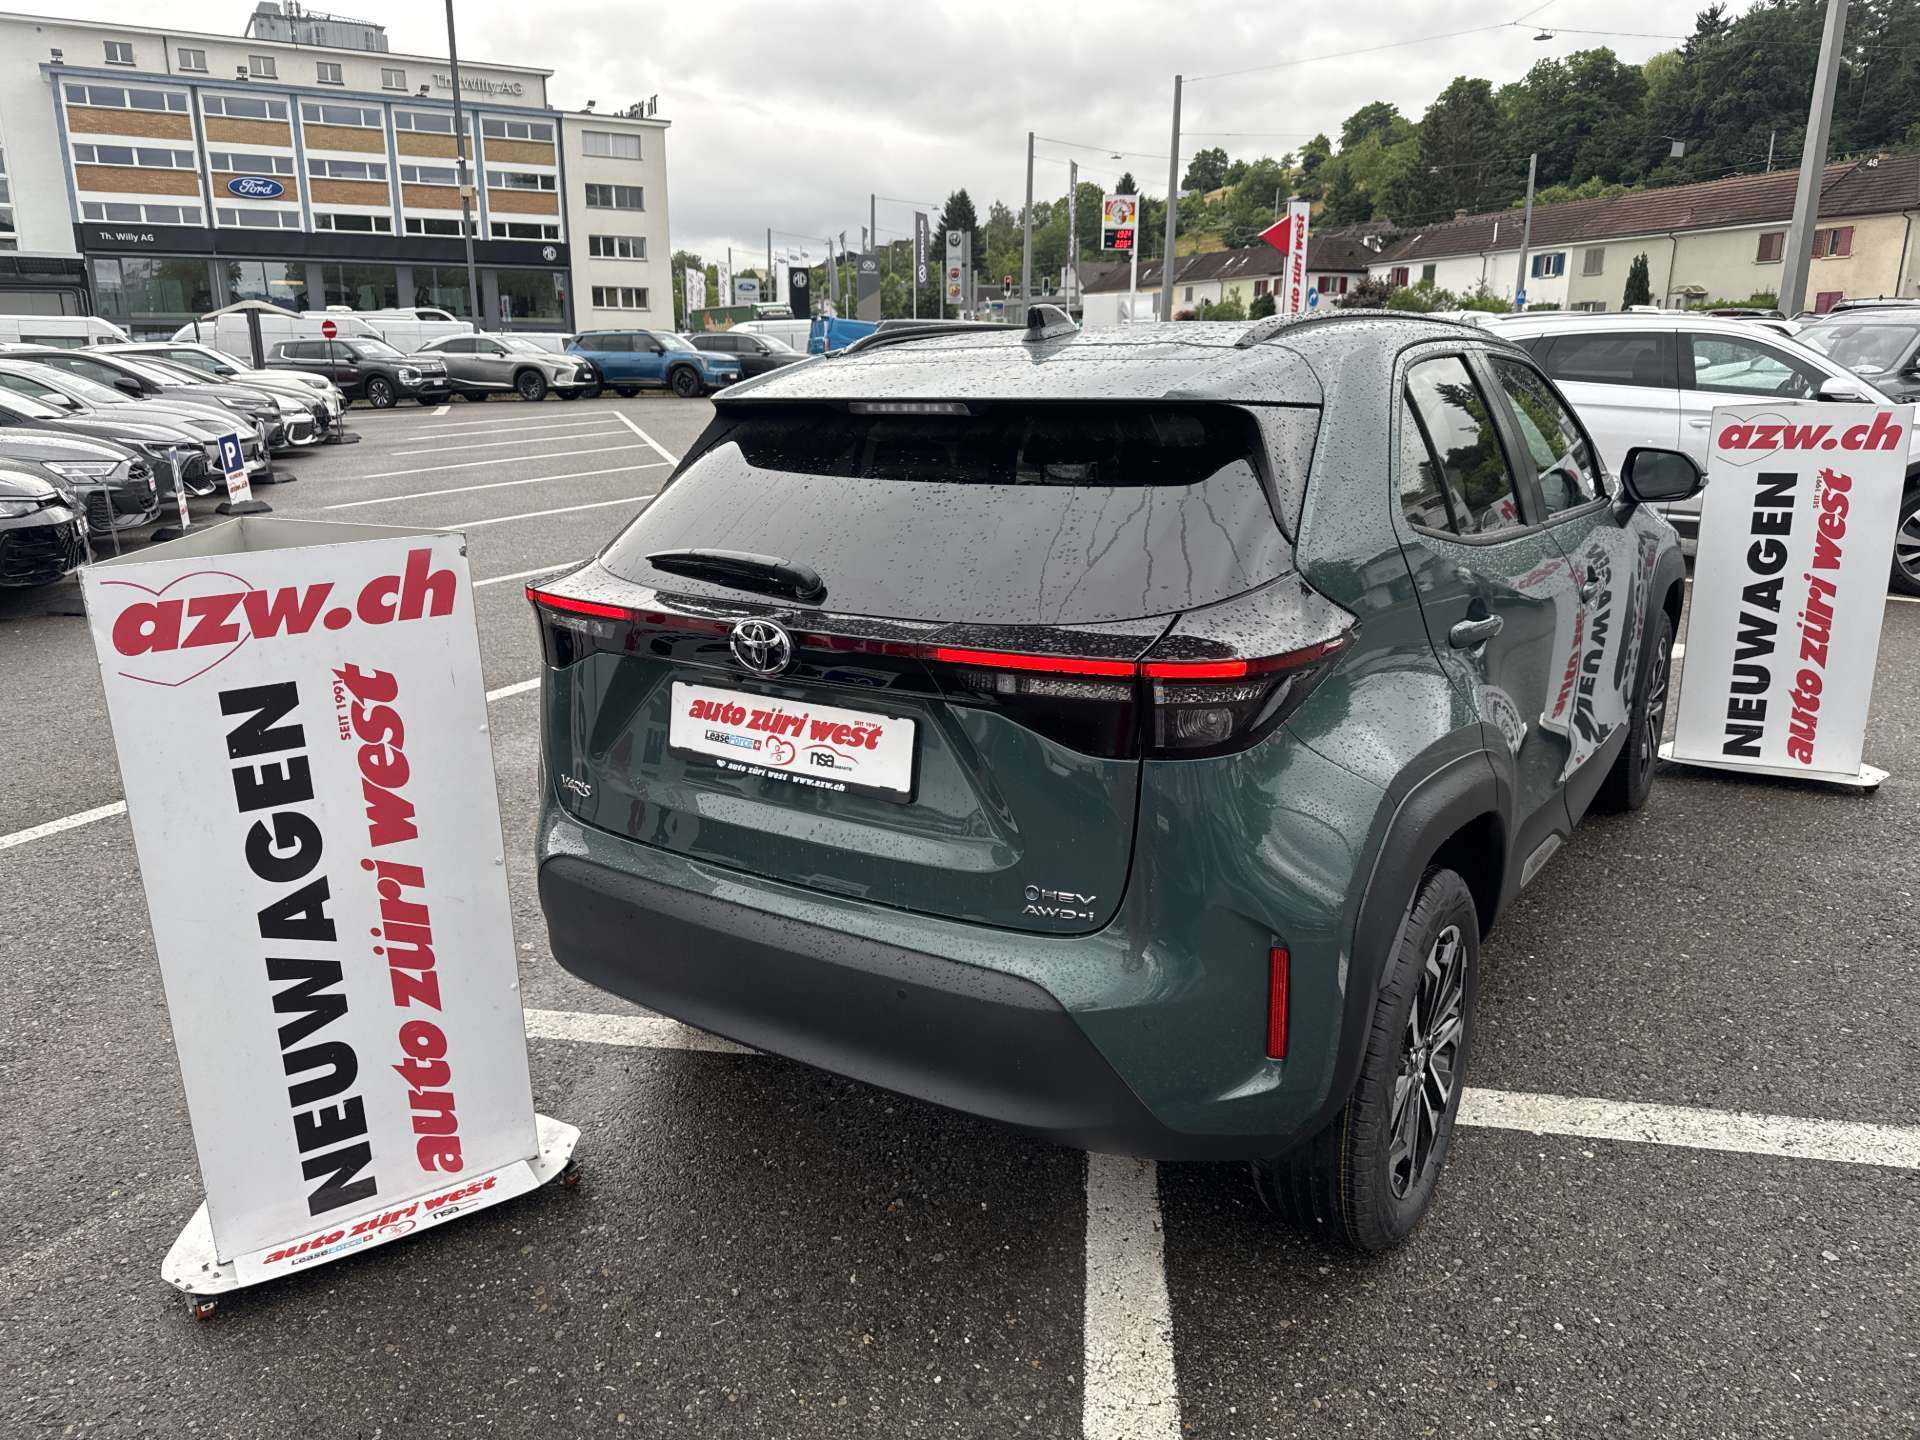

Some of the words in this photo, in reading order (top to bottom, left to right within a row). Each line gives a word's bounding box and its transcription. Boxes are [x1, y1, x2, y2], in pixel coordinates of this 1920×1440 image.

[460, 77, 499, 96] Willy
[502, 80, 524, 96] AG
[1866, 158, 1879, 167] 48
[237, 178, 273, 194] Ford
[100, 231, 114, 241] Th.
[115, 232, 138, 243] Willy
[141, 233, 155, 242] AG
[1295, 213, 1305, 250] west
[542, 246, 557, 261] MG
[792, 271, 808, 288] MG
[1292, 251, 1303, 286] züri
[1290, 287, 1300, 314] uto
[1717, 411, 1904, 451] azw.ch
[224, 441, 236, 468] P
[1815, 474, 1823, 492] 1991
[1812, 494, 1820, 509] SEIT
[1812, 467, 1853, 570] west
[112, 548, 457, 657] azw.ch
[1722, 472, 1799, 758] NEUWAGEN
[1796, 572, 1837, 670] züri
[332, 679, 346, 710] 1991
[338, 714, 352, 741] SEIT
[688, 699, 747, 726] auto
[747, 707, 809, 738] züri
[810, 719, 884, 750] west
[1787, 668, 1823, 764] auto
[331, 662, 419, 847] west
[704, 730, 754, 751] LeaseForce
[810, 751, 835, 768] nsa
[727, 762, 747, 773] auto
[748, 763, 767, 778] züri
[767, 769, 788, 782] west
[792, 775, 846, 792] www.azw.ch
[1041, 888, 1097, 904] HEV
[1022, 904, 1095, 921] AWD-i
[360, 856, 442, 1012] züri
[218, 681, 378, 1217] NEUWAGEN
[391, 1019, 464, 1174] auto
[263, 1230, 345, 1265] auto
[347, 1201, 421, 1239] züri
[424, 1175, 498, 1211] west
[432, 1206, 460, 1221] nsa
